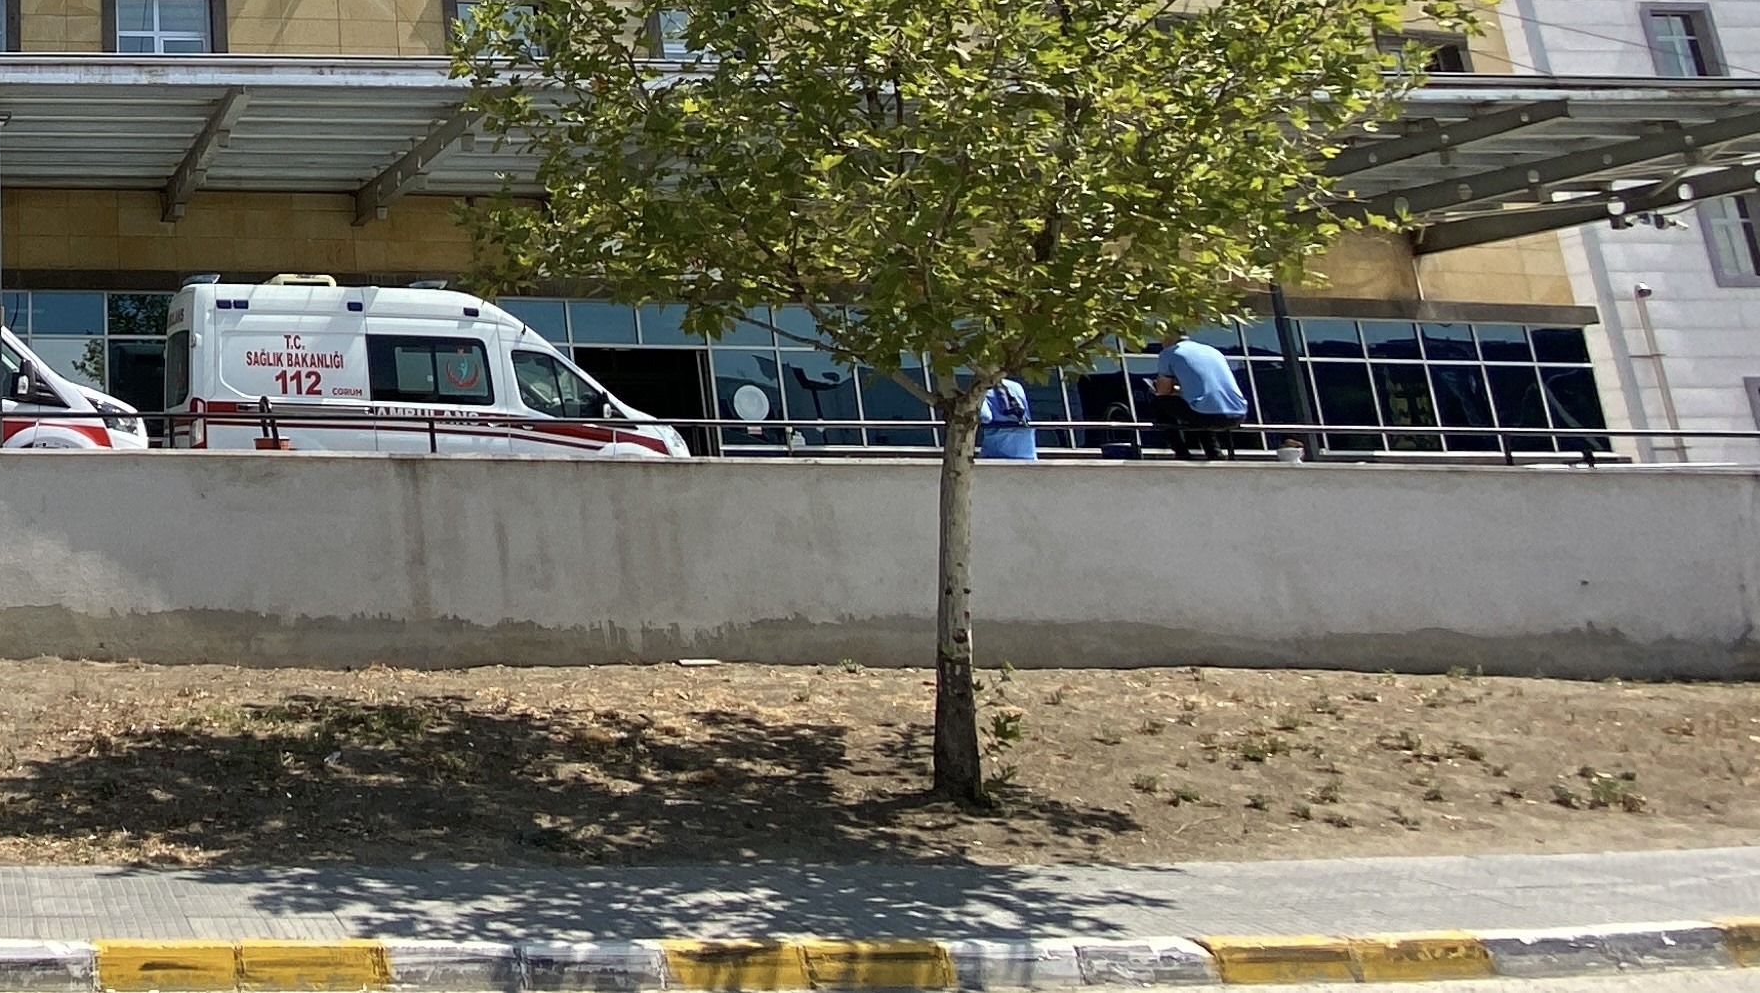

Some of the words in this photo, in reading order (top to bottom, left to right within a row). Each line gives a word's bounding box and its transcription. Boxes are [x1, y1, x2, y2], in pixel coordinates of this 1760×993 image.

[284, 334, 305, 350] T.C.
[246, 348, 284, 368] SAĞLIK
[287, 350, 345, 369] BAKANLIĞI
[275, 369, 323, 396] 112
